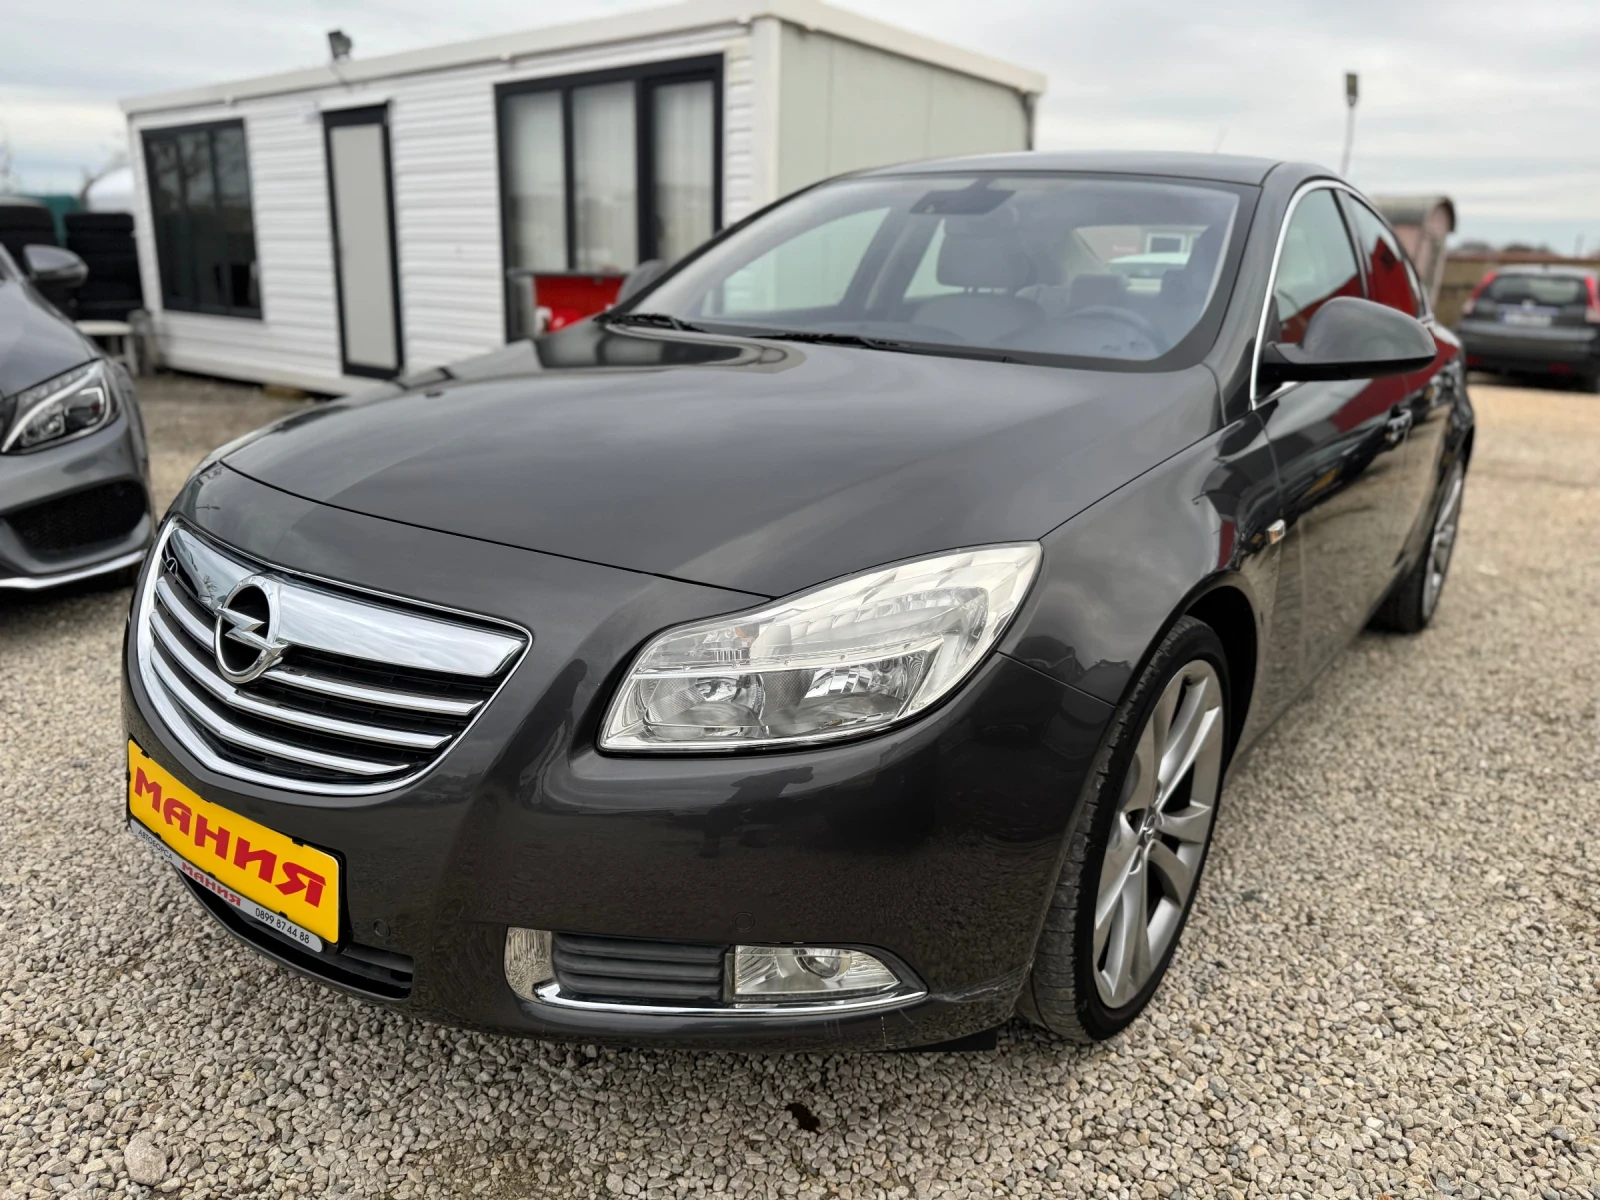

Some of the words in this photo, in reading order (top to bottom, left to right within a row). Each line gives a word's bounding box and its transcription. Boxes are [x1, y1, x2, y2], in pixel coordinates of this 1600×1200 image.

[134, 766, 326, 908] МАНИЯ
[138, 829, 173, 860] АВТОБОРСА
[182, 862, 241, 906] МАНИЯ
[255, 907, 275, 924] 0899
[276, 919, 287, 930] 87
[286, 925, 298, 937] 44
[299, 931, 310, 944] 88
